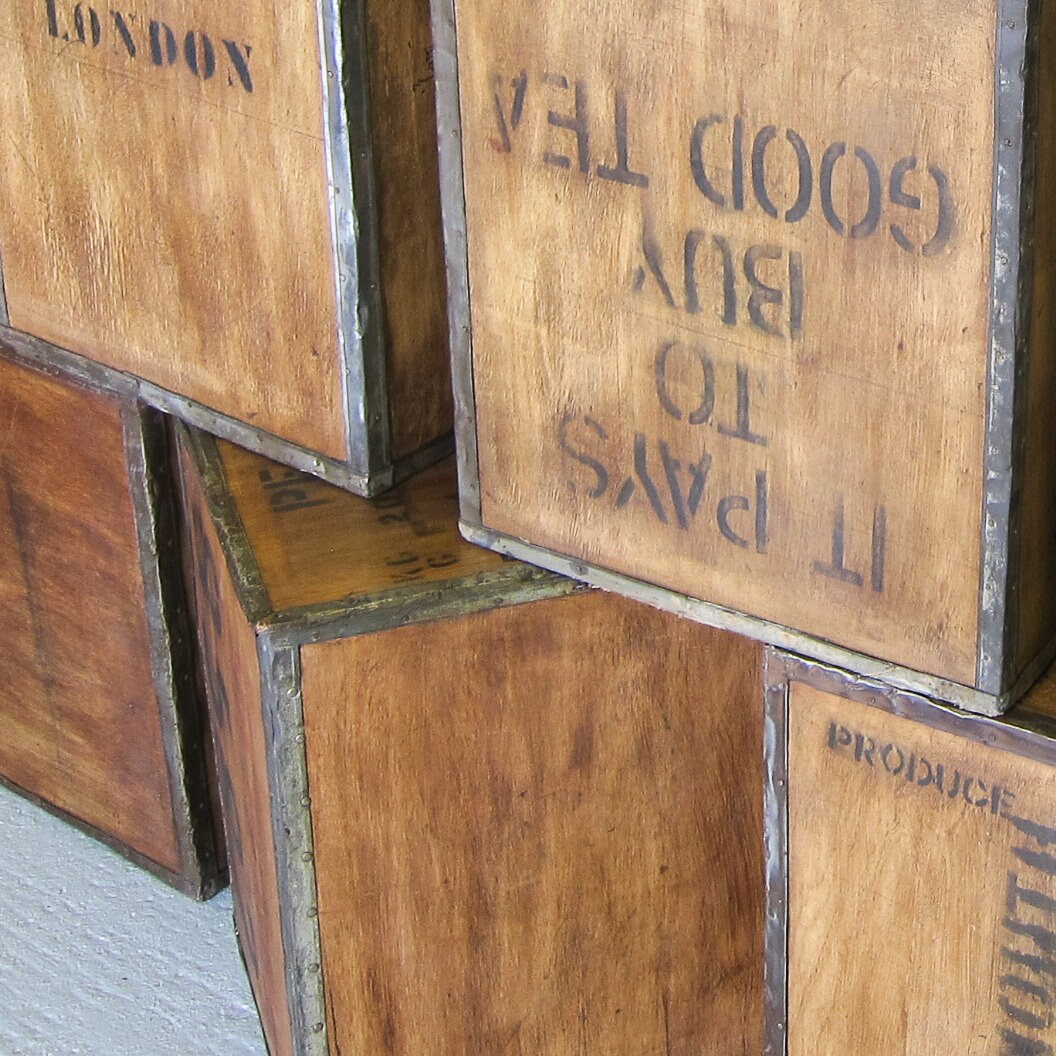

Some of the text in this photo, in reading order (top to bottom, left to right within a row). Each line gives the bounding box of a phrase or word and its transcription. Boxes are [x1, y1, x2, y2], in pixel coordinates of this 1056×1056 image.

[490, 71, 958, 256] GOOD TEA
[630, 192, 805, 342] BUY
[655, 339, 769, 447] TO
[557, 411, 887, 594] IT PAYS
[828, 721, 1017, 819] PRODUCE
